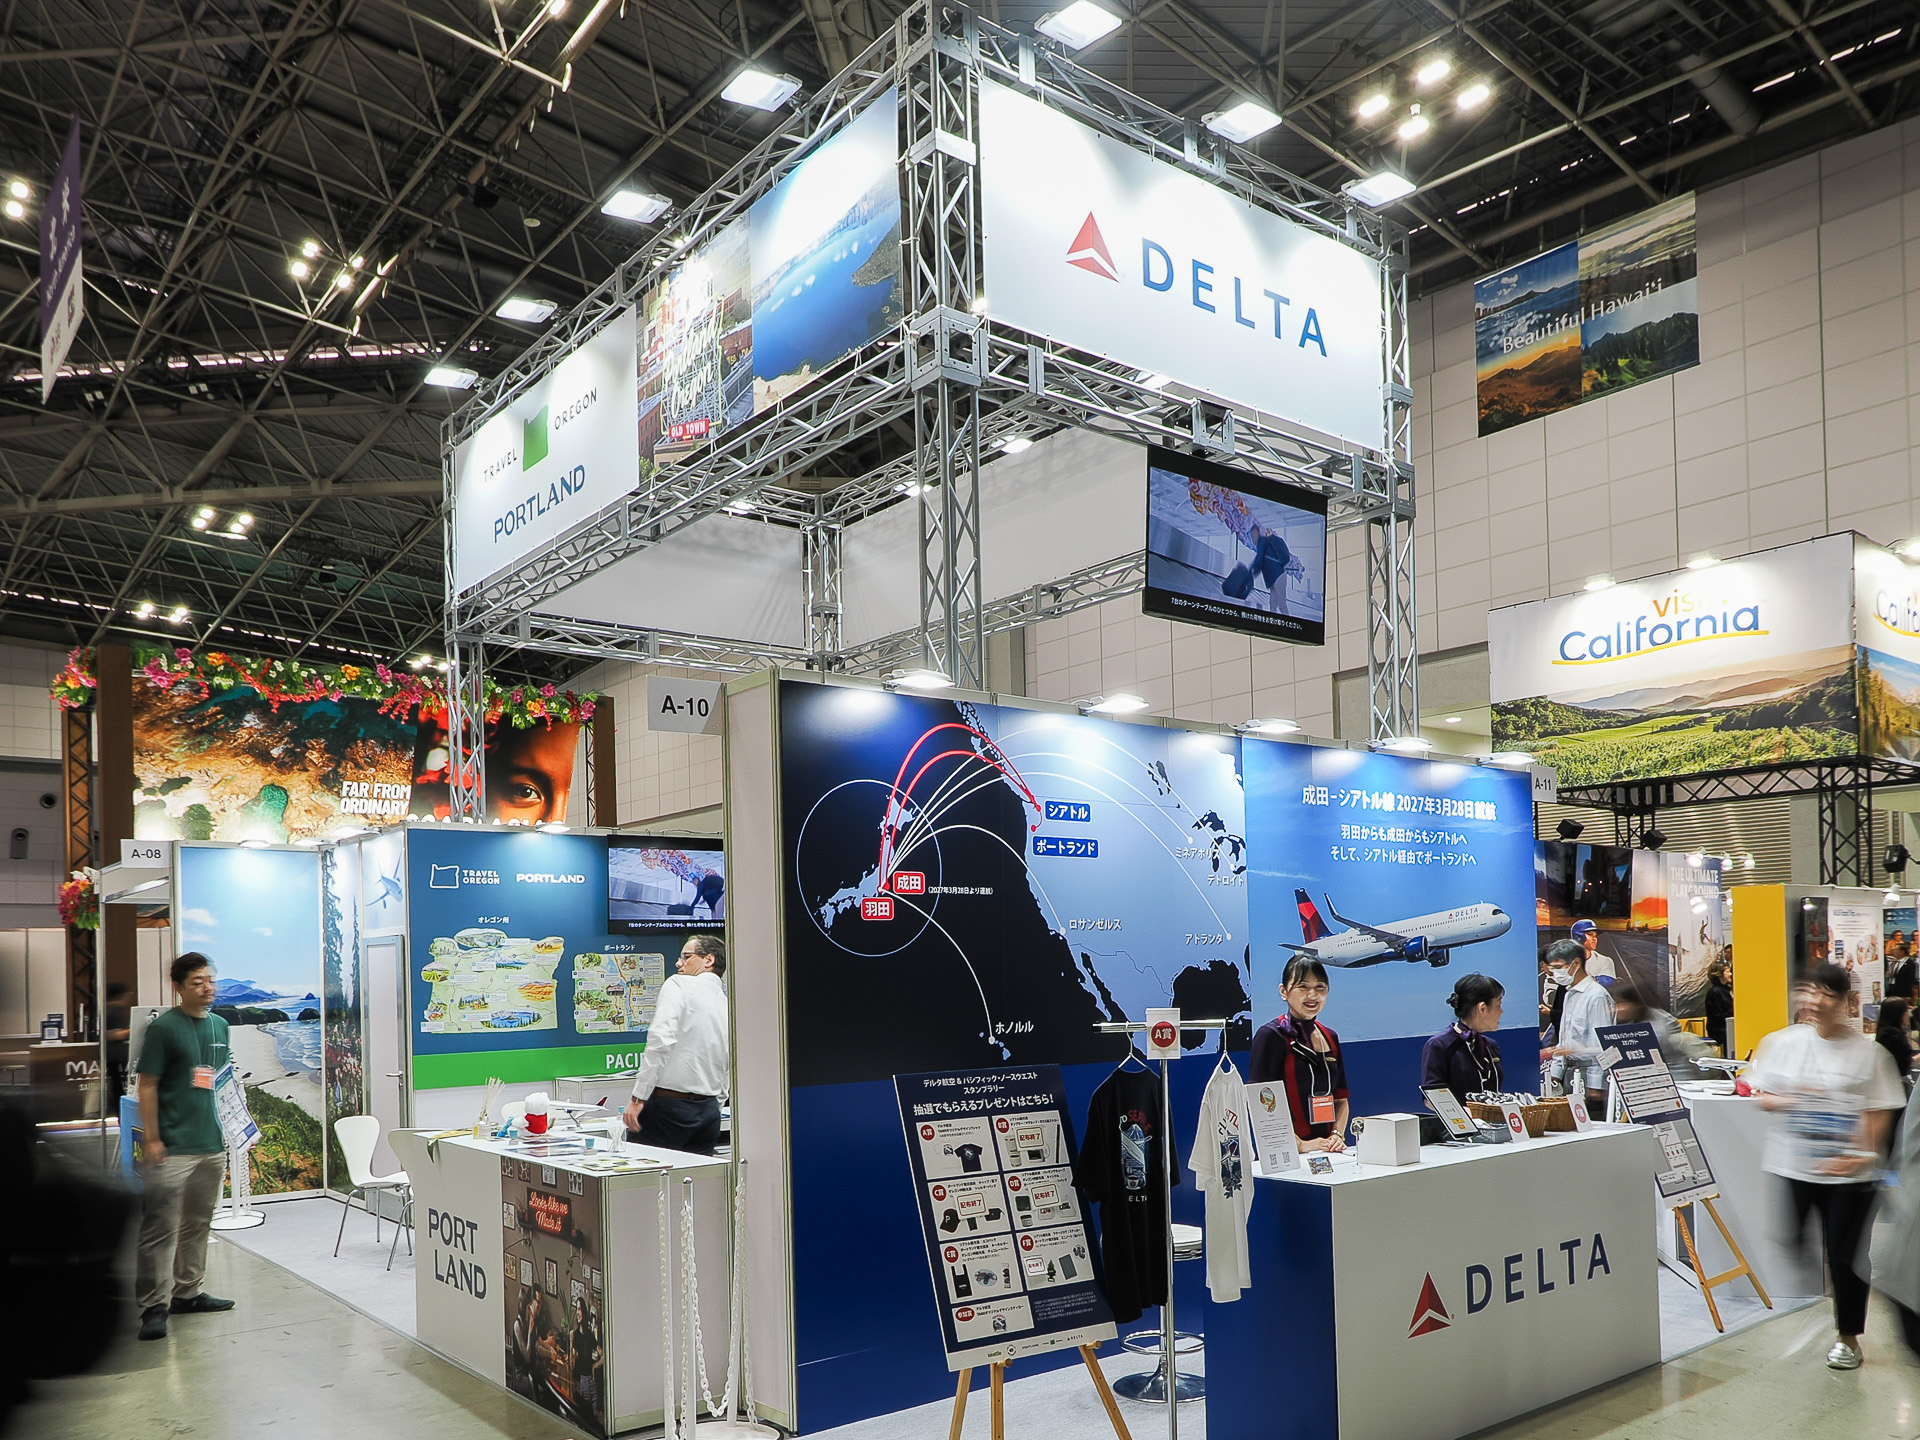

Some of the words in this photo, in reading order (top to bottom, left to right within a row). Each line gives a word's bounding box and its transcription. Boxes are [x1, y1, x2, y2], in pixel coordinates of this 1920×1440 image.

[1141, 237, 1328, 358] DELTA
[1502, 304, 1587, 355] Beautiful
[671, 362, 715, 419] Oregon
[483, 449, 519, 482] TRAVEL
[554, 388, 598, 431] OREGON
[671, 425, 683, 438] OLD
[686, 420, 706, 435] TOWN
[493, 464, 586, 544] PORTLAND
[1558, 604, 1760, 661] California
[661, 694, 710, 717] A-10
[342, 781, 369, 798] FAR
[372, 784, 412, 800] FROM
[1534, 776, 1553, 791] A-11
[340, 798, 410, 816] ORDINARY
[1047, 803, 1088, 820] シアトル
[1340, 824, 1468, 846] 羽田からも成田からもシアトルへ
[130, 848, 162, 860] A-08
[1036, 839, 1096, 856] ポートランド
[1175, 846, 1220, 860] ミネアポリス
[1330, 845, 1477, 867] そして、シアトル経由でポートランドへ
[462, 869, 499, 878] TRAVEL
[462, 877, 501, 885] OREGON
[516, 873, 586, 884] PORTLAND
[1207, 873, 1244, 886] デトロイト
[1671, 866, 1685, 881] THE
[1685, 867, 1719, 884] ULTIMATE
[897, 874, 922, 892] 成田
[864, 901, 890, 918] 羽田
[1455, 907, 1480, 918] DELTA
[477, 915, 510, 924] オレゴン州
[1069, 917, 1122, 931] ロサンゼルス
[603, 943, 637, 952] ポートランド
[1185, 933, 1224, 945] アトランタ
[995, 1020, 1034, 1034] ホノルル
[1154, 1027, 1173, 1040] A賞
[963, 1085, 1005, 1095] スタンプラリー
[912, 1093, 1055, 1117] 抽選でもらえるプレゼントはこちら!
[529, 1191, 547, 1209] Looks
[548, 1195, 559, 1212] like
[560, 1202, 569, 1215] we
[535, 1210, 555, 1230] Made
[555, 1216, 562, 1232] it
[427, 1207, 479, 1255] PORT
[434, 1248, 488, 1301] LAND
[1465, 1232, 1612, 1315] DELTA
